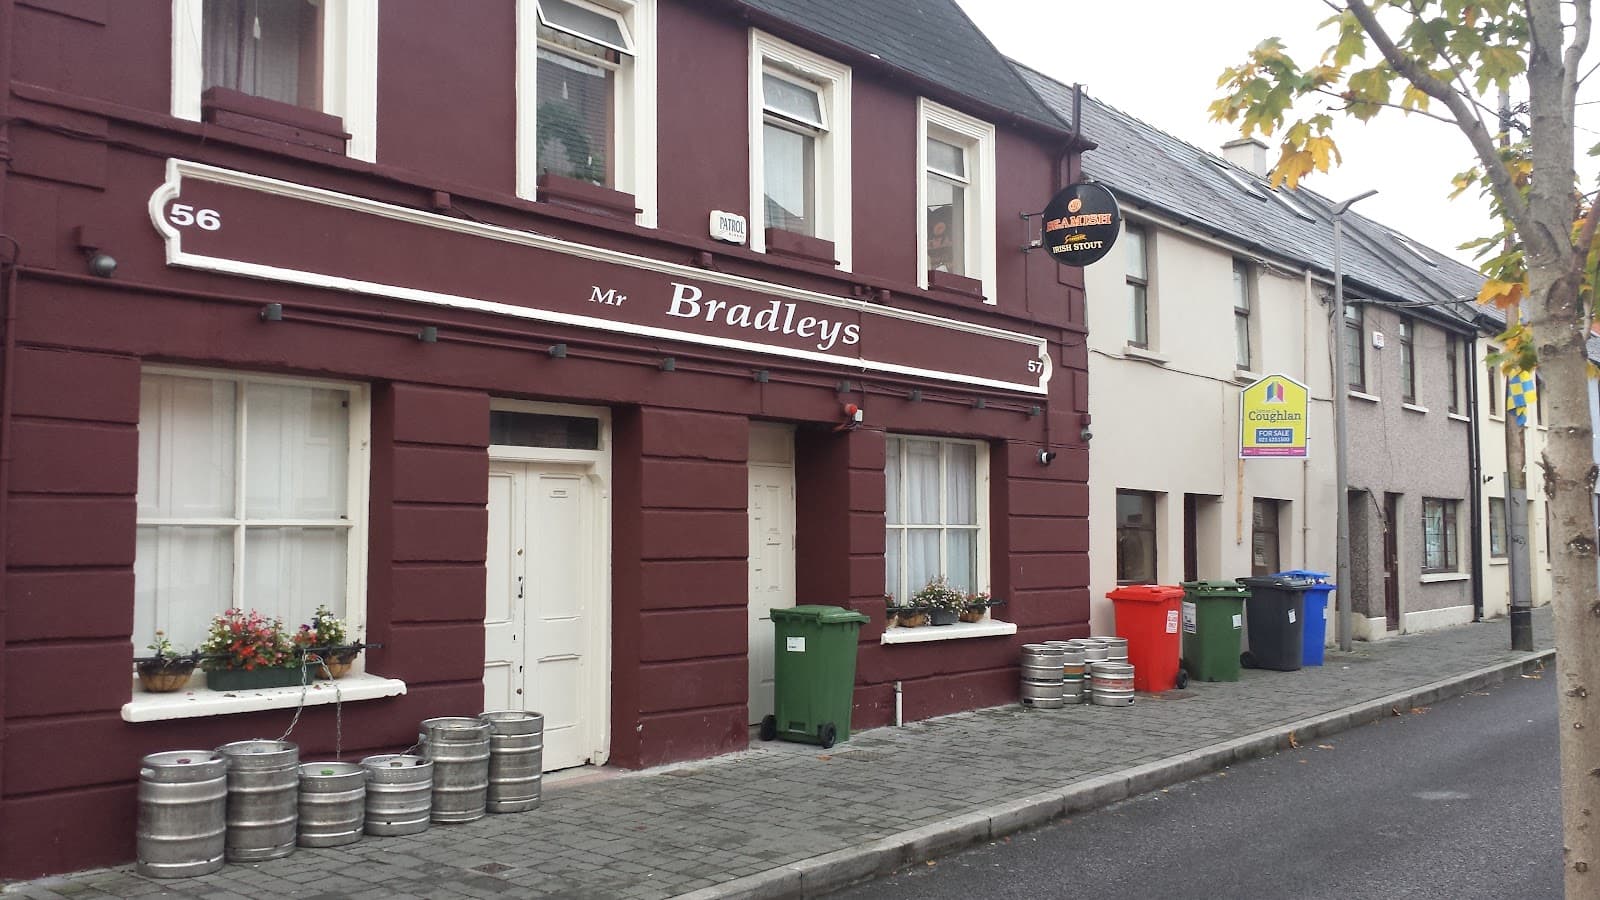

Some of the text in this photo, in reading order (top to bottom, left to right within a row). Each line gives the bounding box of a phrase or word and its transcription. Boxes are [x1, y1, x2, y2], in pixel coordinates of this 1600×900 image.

[170, 203, 221, 231] 56
[719, 216, 744, 234] PATROL
[1052, 241, 1103, 254] IRISH STOUT
[588, 282, 861, 351] Mr Bradleys
[1028, 360, 1043, 374] 57
[1248, 410, 1301, 423] Coughlan
